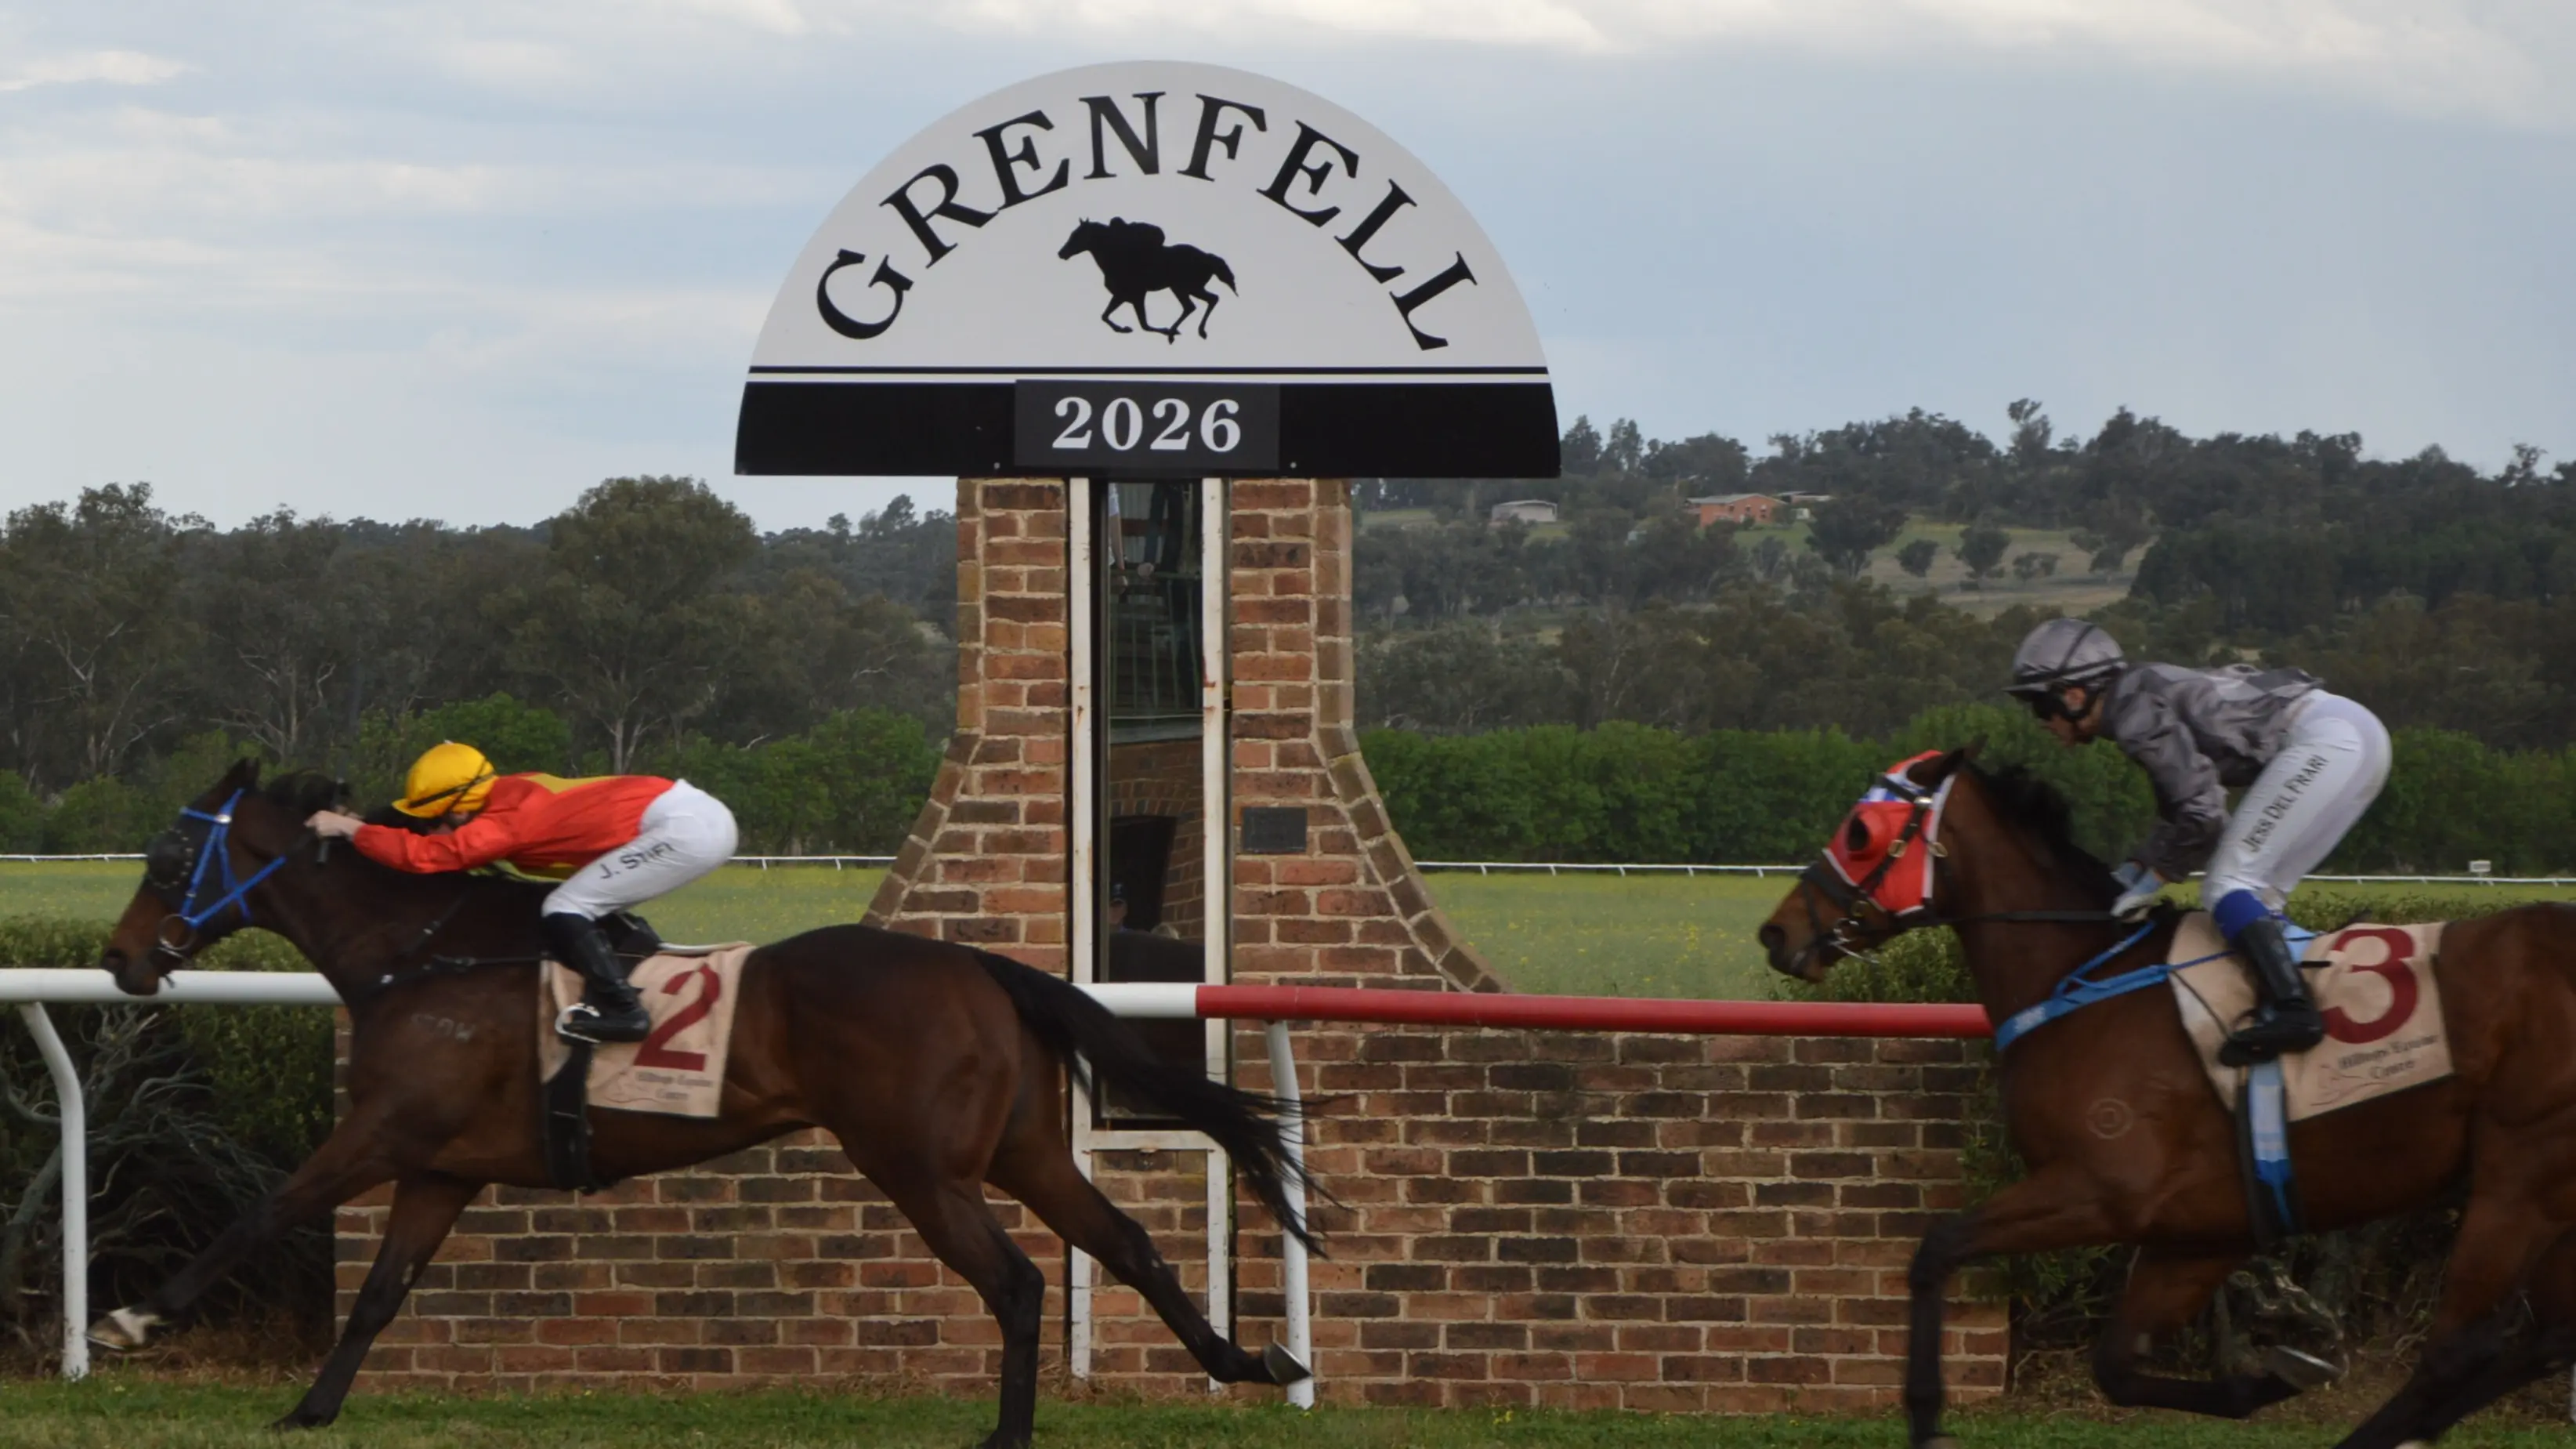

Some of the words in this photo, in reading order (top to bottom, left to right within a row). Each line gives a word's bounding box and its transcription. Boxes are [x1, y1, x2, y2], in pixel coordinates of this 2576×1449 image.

[816, 91, 1478, 351] GRENFELL
[1051, 396, 1241, 452] 2026
[2241, 818, 2276, 853] JESS
[2262, 794, 2299, 820] DEL
[600, 863, 620, 878] J.
[634, 963, 721, 1071] 2
[2322, 928, 2418, 1044] 3
